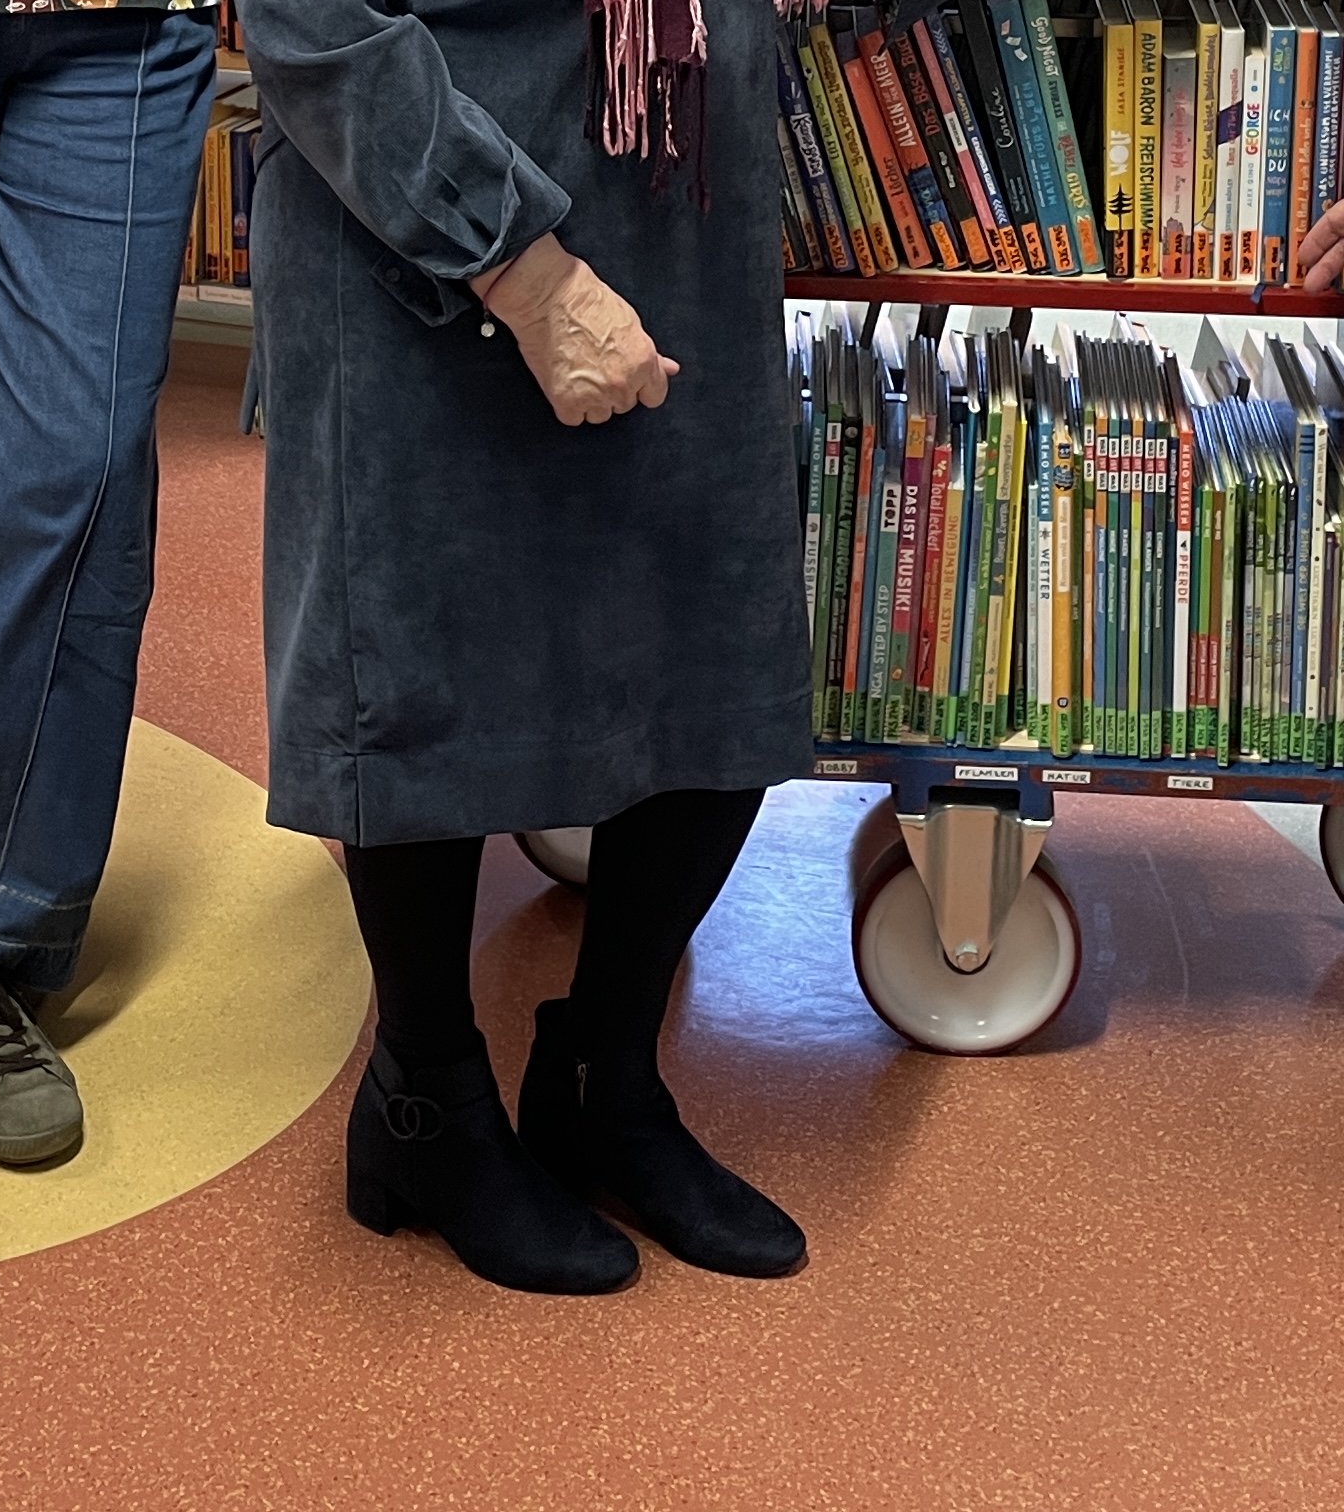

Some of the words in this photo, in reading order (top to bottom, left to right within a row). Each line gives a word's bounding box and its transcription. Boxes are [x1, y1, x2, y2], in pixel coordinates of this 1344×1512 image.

[1141, 33, 1156, 72] ADAM
[1140, 77, 1155, 126] BARON
[1246, 103, 1259, 155] GEORGE
[1269, 160, 1287, 172] DU
[884, 489, 897, 528] TOPP
[904, 486, 918, 513] DAS
[903, 519, 915, 540] IST
[943, 515, 959, 584] BEWEGUNG
[895, 548, 913, 612] MUSIK!
[942, 586, 953, 600] IN
[1177, 555, 1188, 604] PFERDE
[877, 585, 889, 614] STEP
[876, 617, 888, 632] BY
[938, 605, 952, 644] ALLES
[873, 636, 885, 664] STEP
[1047, 773, 1087, 782] NATUR
[1172, 779, 1210, 789] TIERE
